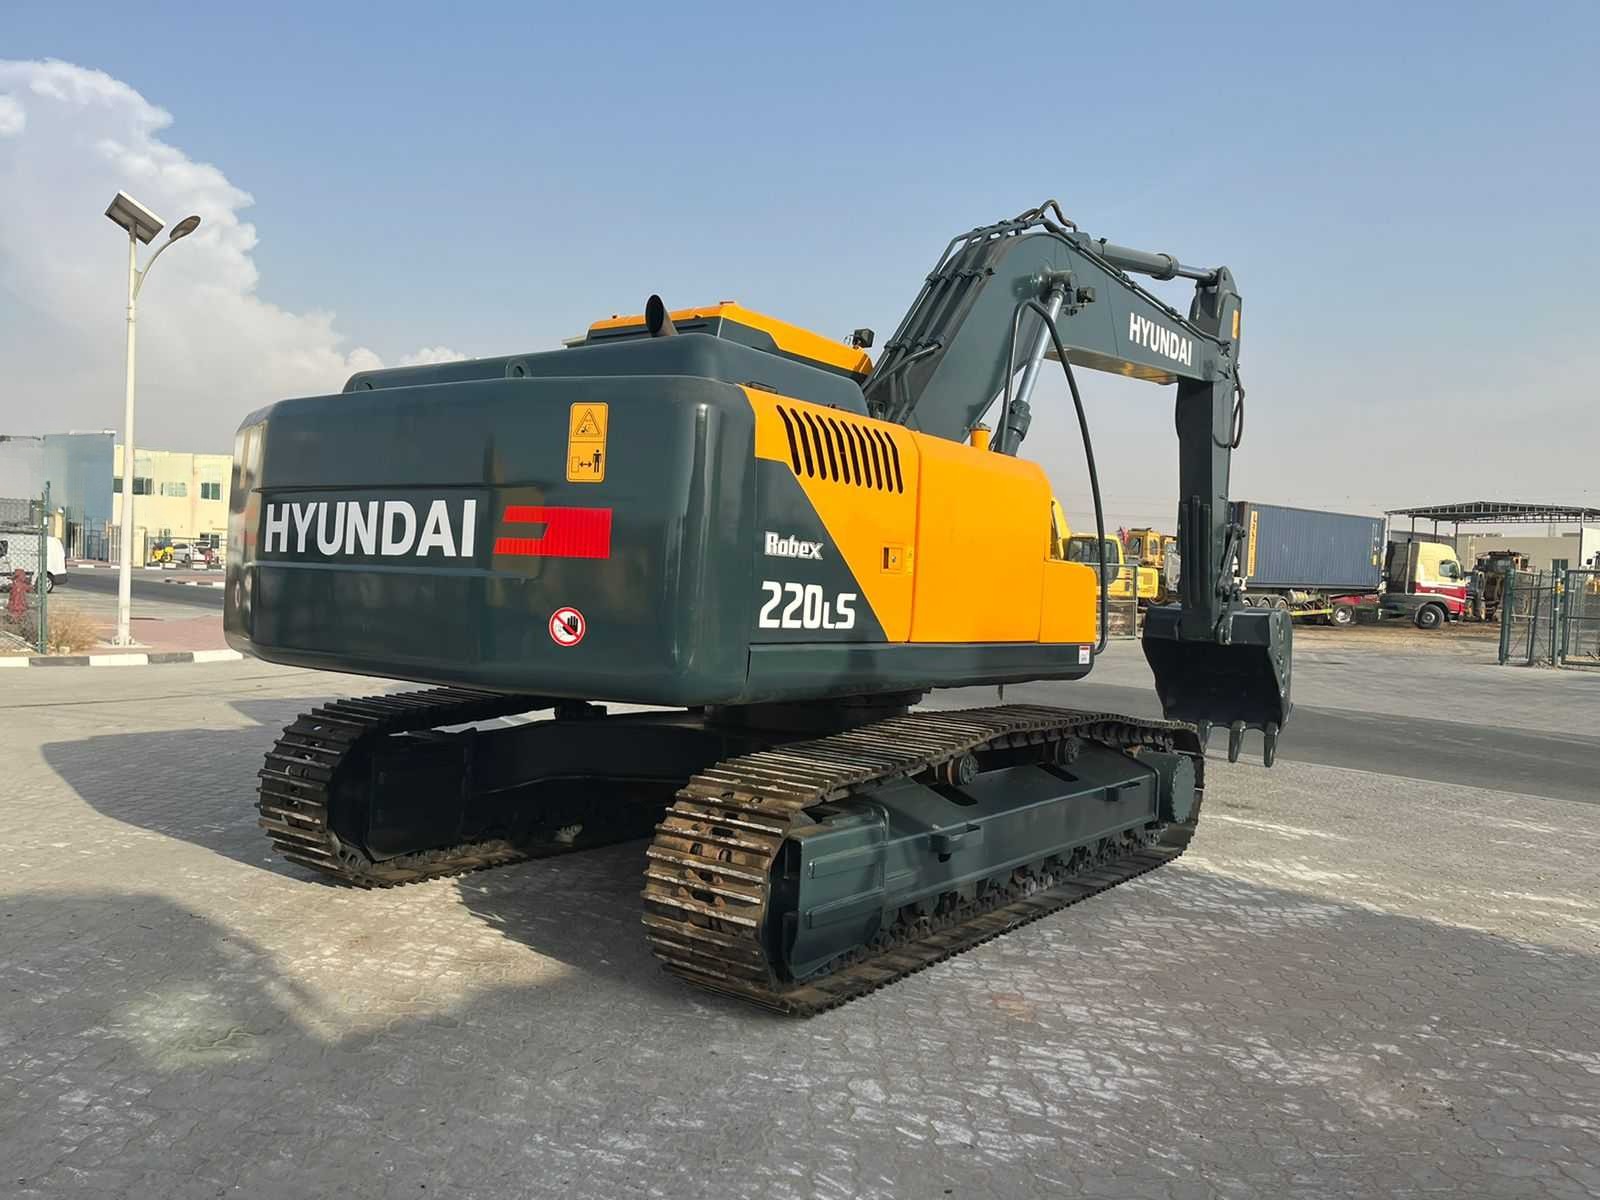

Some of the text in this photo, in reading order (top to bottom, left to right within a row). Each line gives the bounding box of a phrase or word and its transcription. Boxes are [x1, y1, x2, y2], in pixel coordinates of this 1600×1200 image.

[1129, 312, 1192, 366] HYUNDAI
[264, 500, 477, 557] HYUNDAI
[764, 531, 824, 560] Robex
